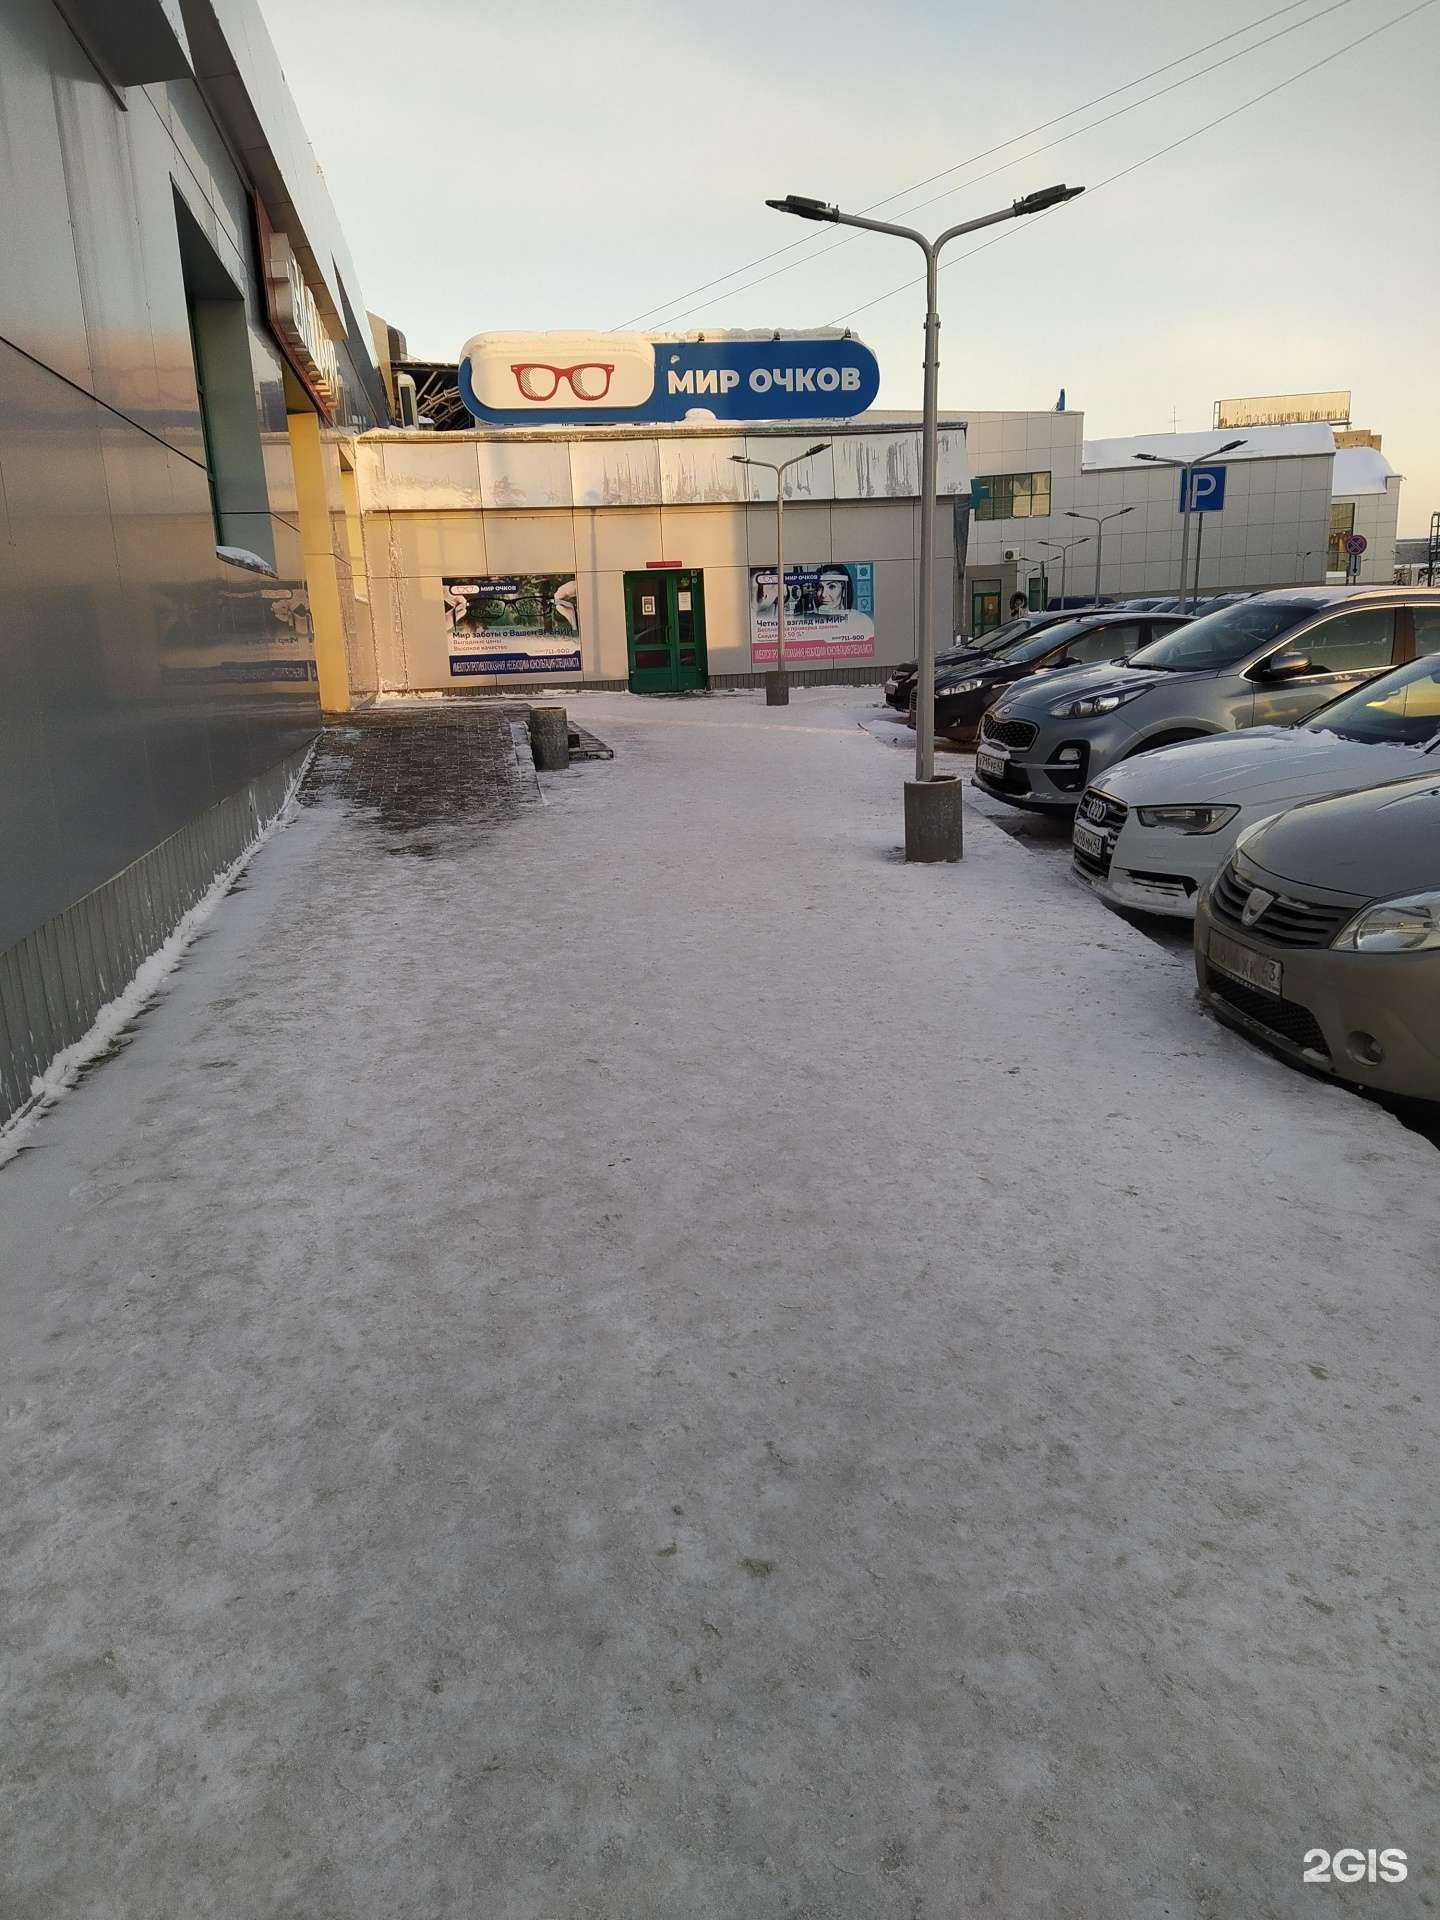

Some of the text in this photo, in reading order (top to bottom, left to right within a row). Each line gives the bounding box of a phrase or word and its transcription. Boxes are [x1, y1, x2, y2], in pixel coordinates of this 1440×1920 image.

[667, 367, 861, 395] МИР ОЧКОВ
[1191, 473, 1217, 508] P
[756, 619, 778, 627] Четки
[452, 631, 471, 640] Мир
